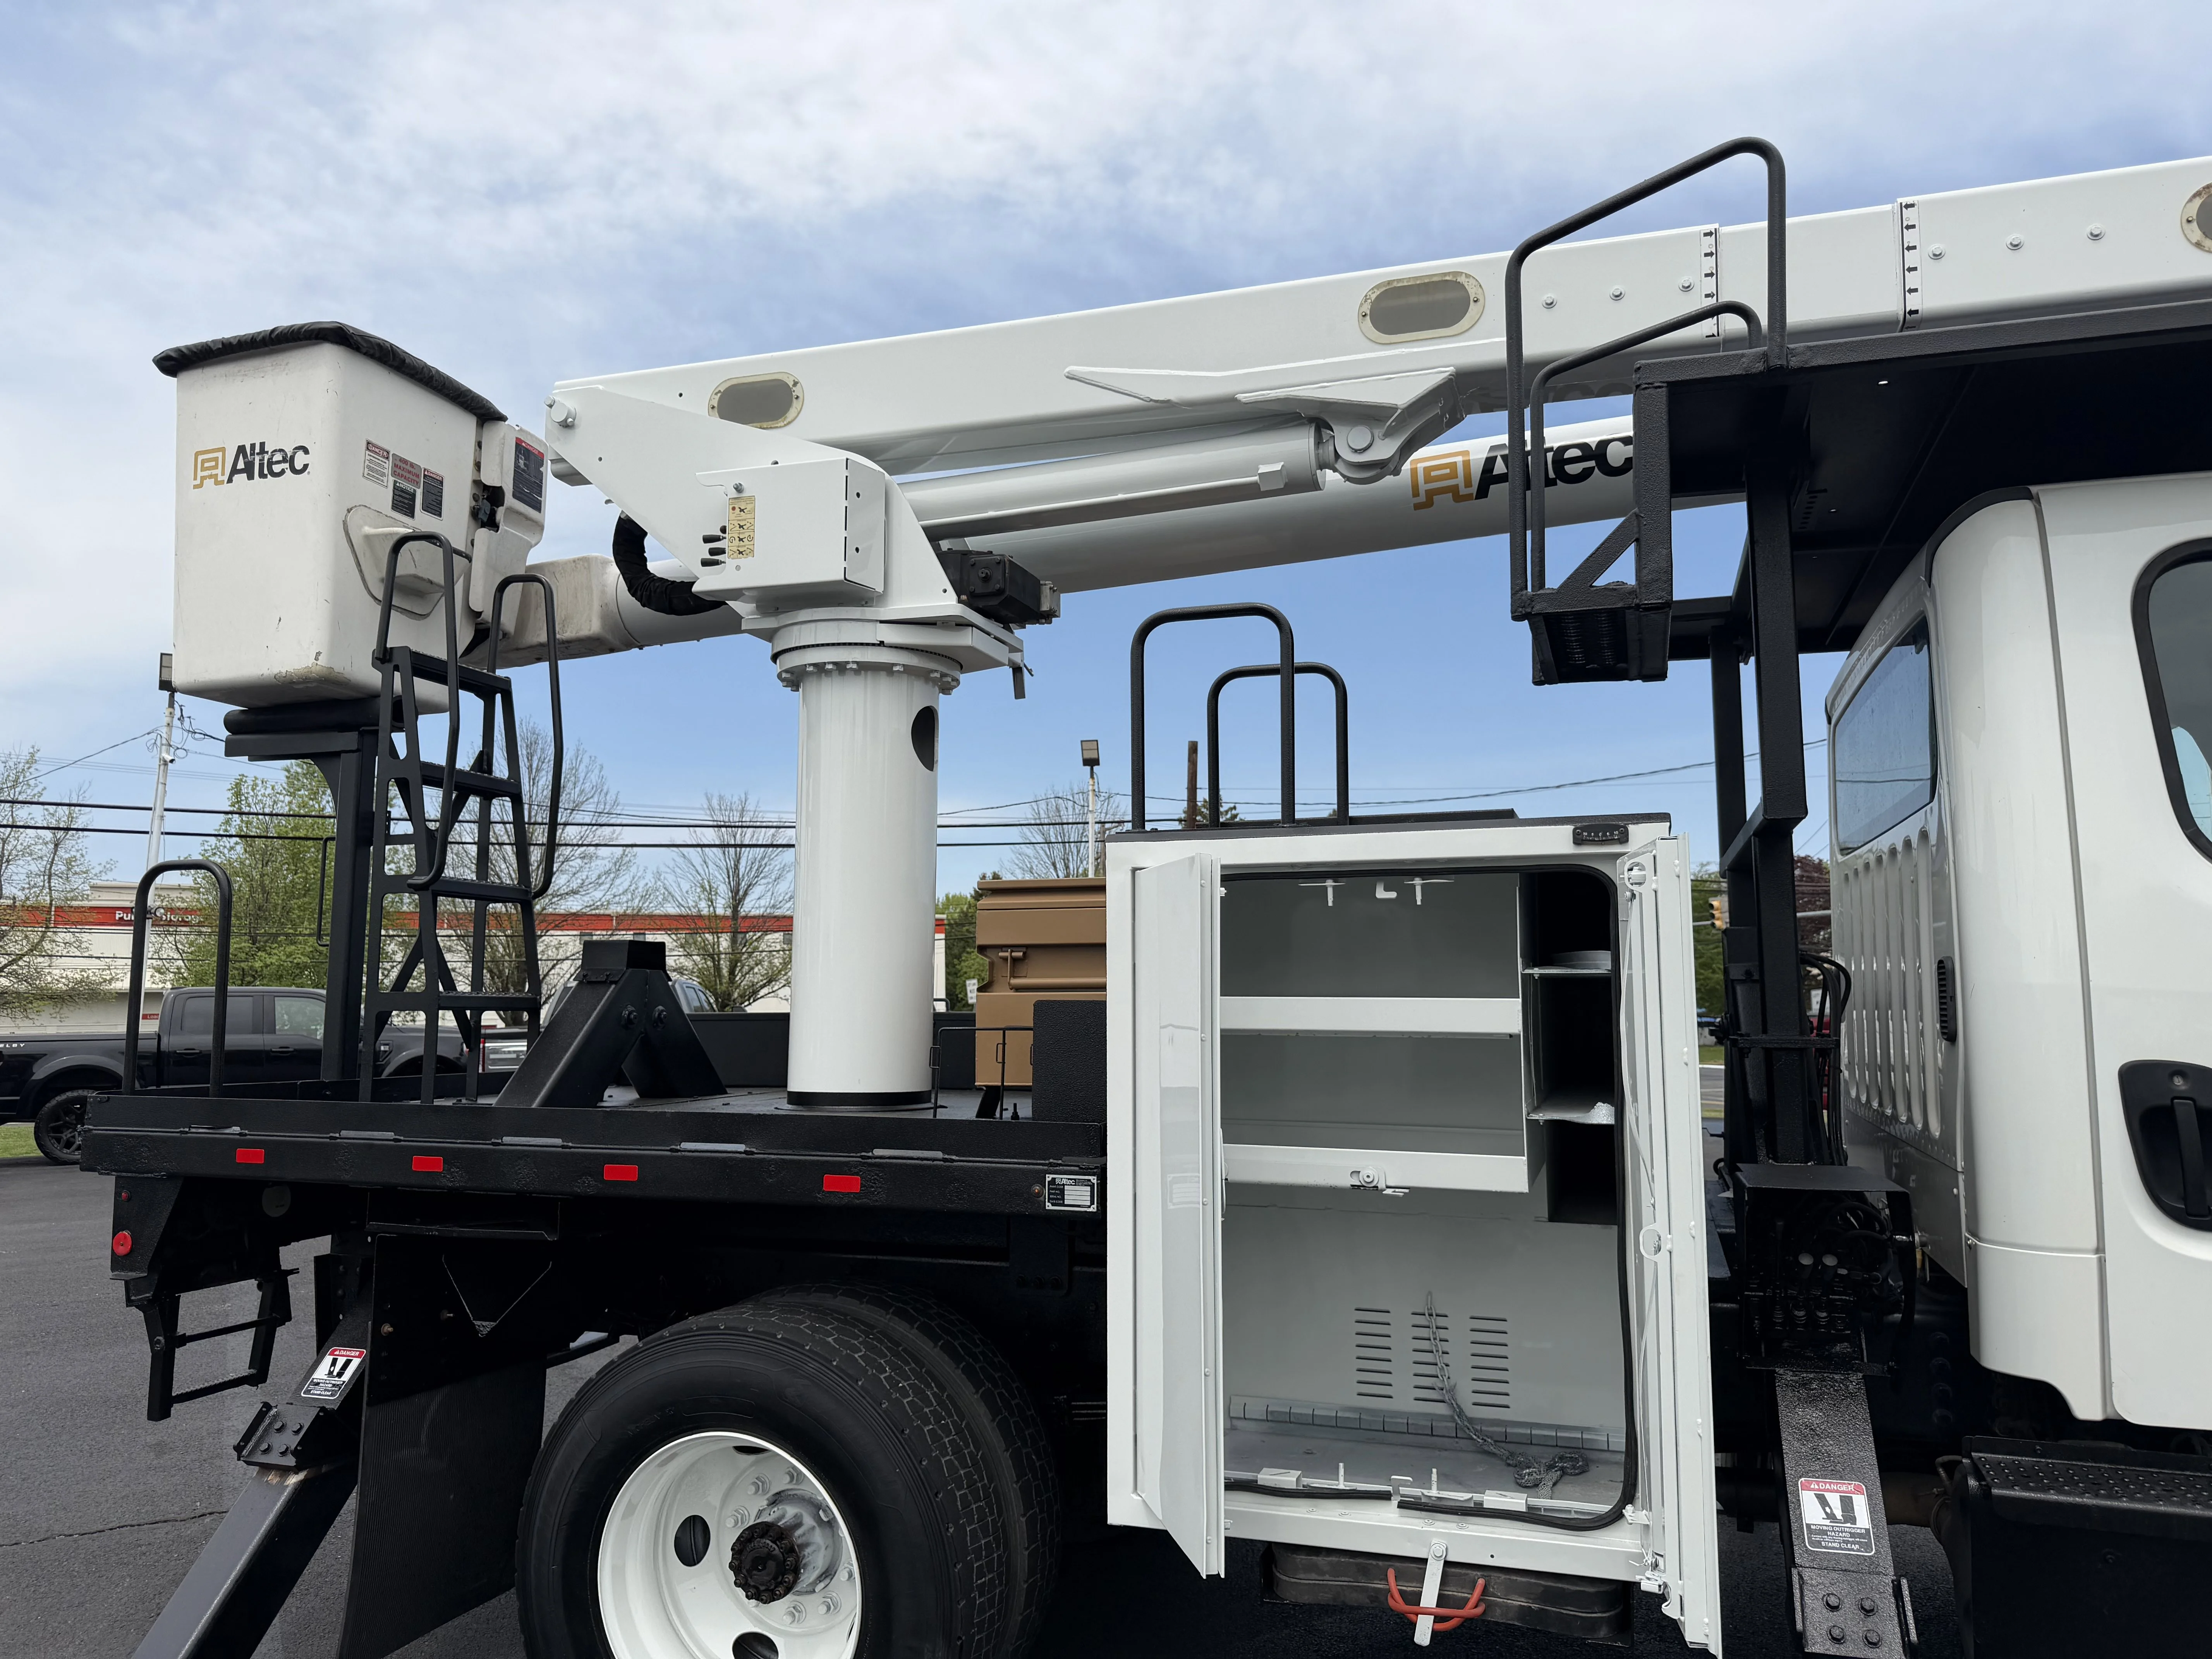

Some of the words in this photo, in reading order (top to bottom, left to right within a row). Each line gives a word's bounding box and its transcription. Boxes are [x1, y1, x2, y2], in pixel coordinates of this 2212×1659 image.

[226, 441, 310, 484] Altec
[399, 458, 408, 466] 400
[1475, 433, 1633, 500] Aec
[393, 471, 419, 486] CAPACITY
[394, 463, 419, 479] MAXIMUM
[400, 483, 414, 493] NOTICE
[1819, 1483, 1854, 1491] DANGER
